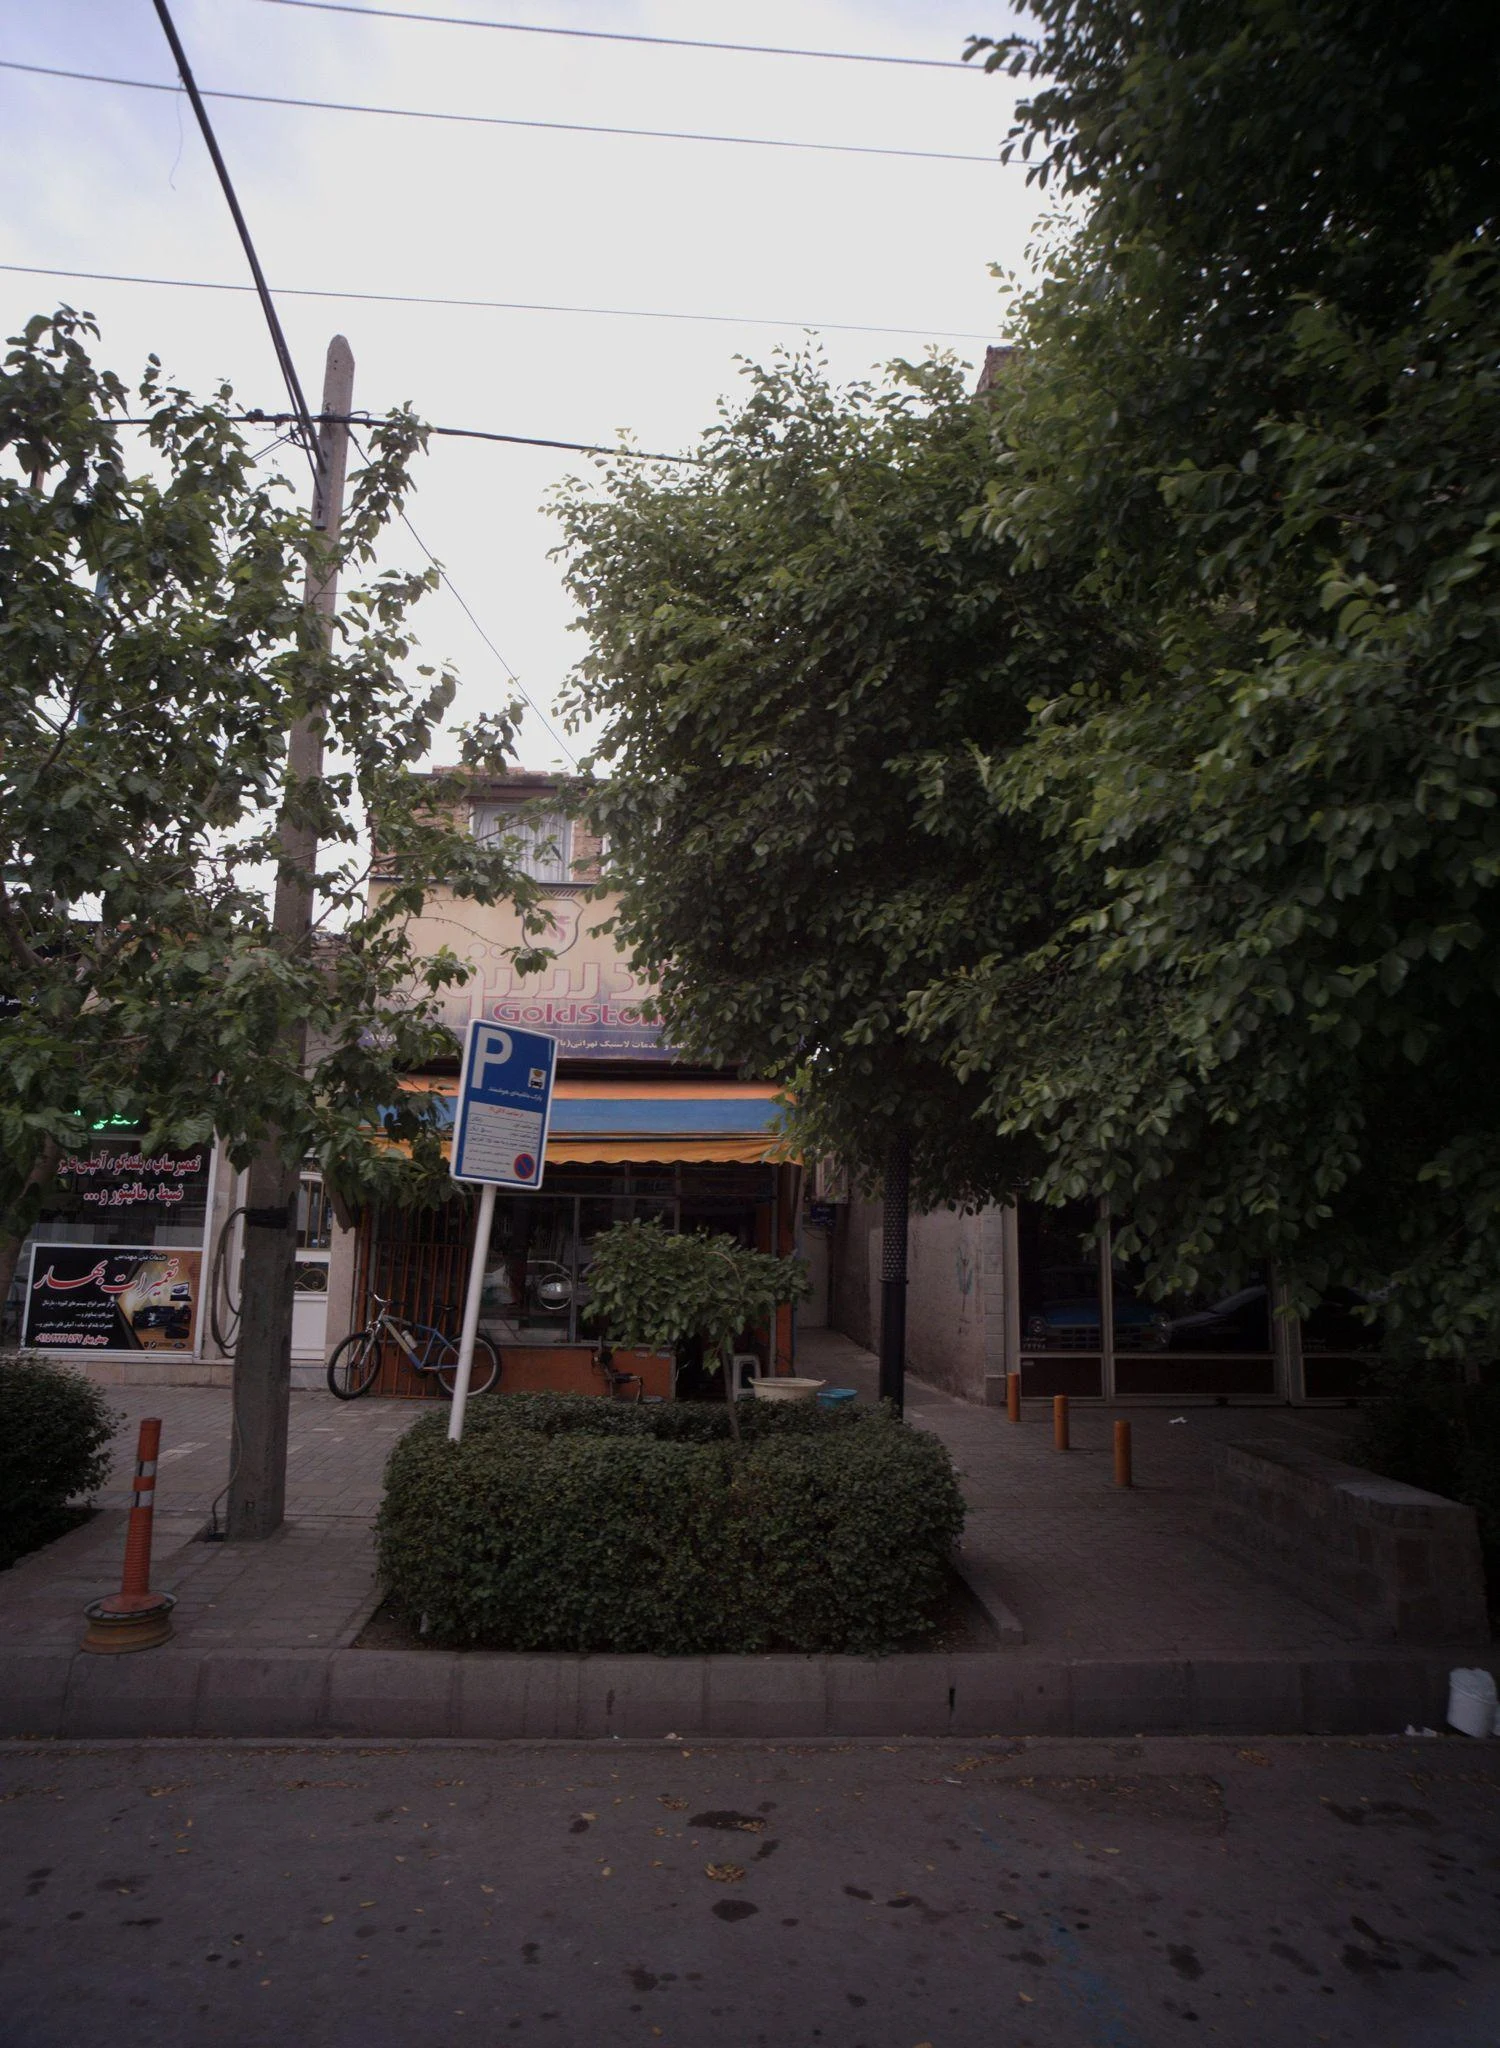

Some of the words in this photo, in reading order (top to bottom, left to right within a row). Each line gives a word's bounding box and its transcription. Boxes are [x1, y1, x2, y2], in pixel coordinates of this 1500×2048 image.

[471, 1026, 513, 1089] P
[173, 1154, 202, 1176] تعمیر
[108, 1183, 147, 1205] مانیتور
[33, 1259, 108, 1290] بهار
[100, 1258, 180, 1298] تعمیرات
